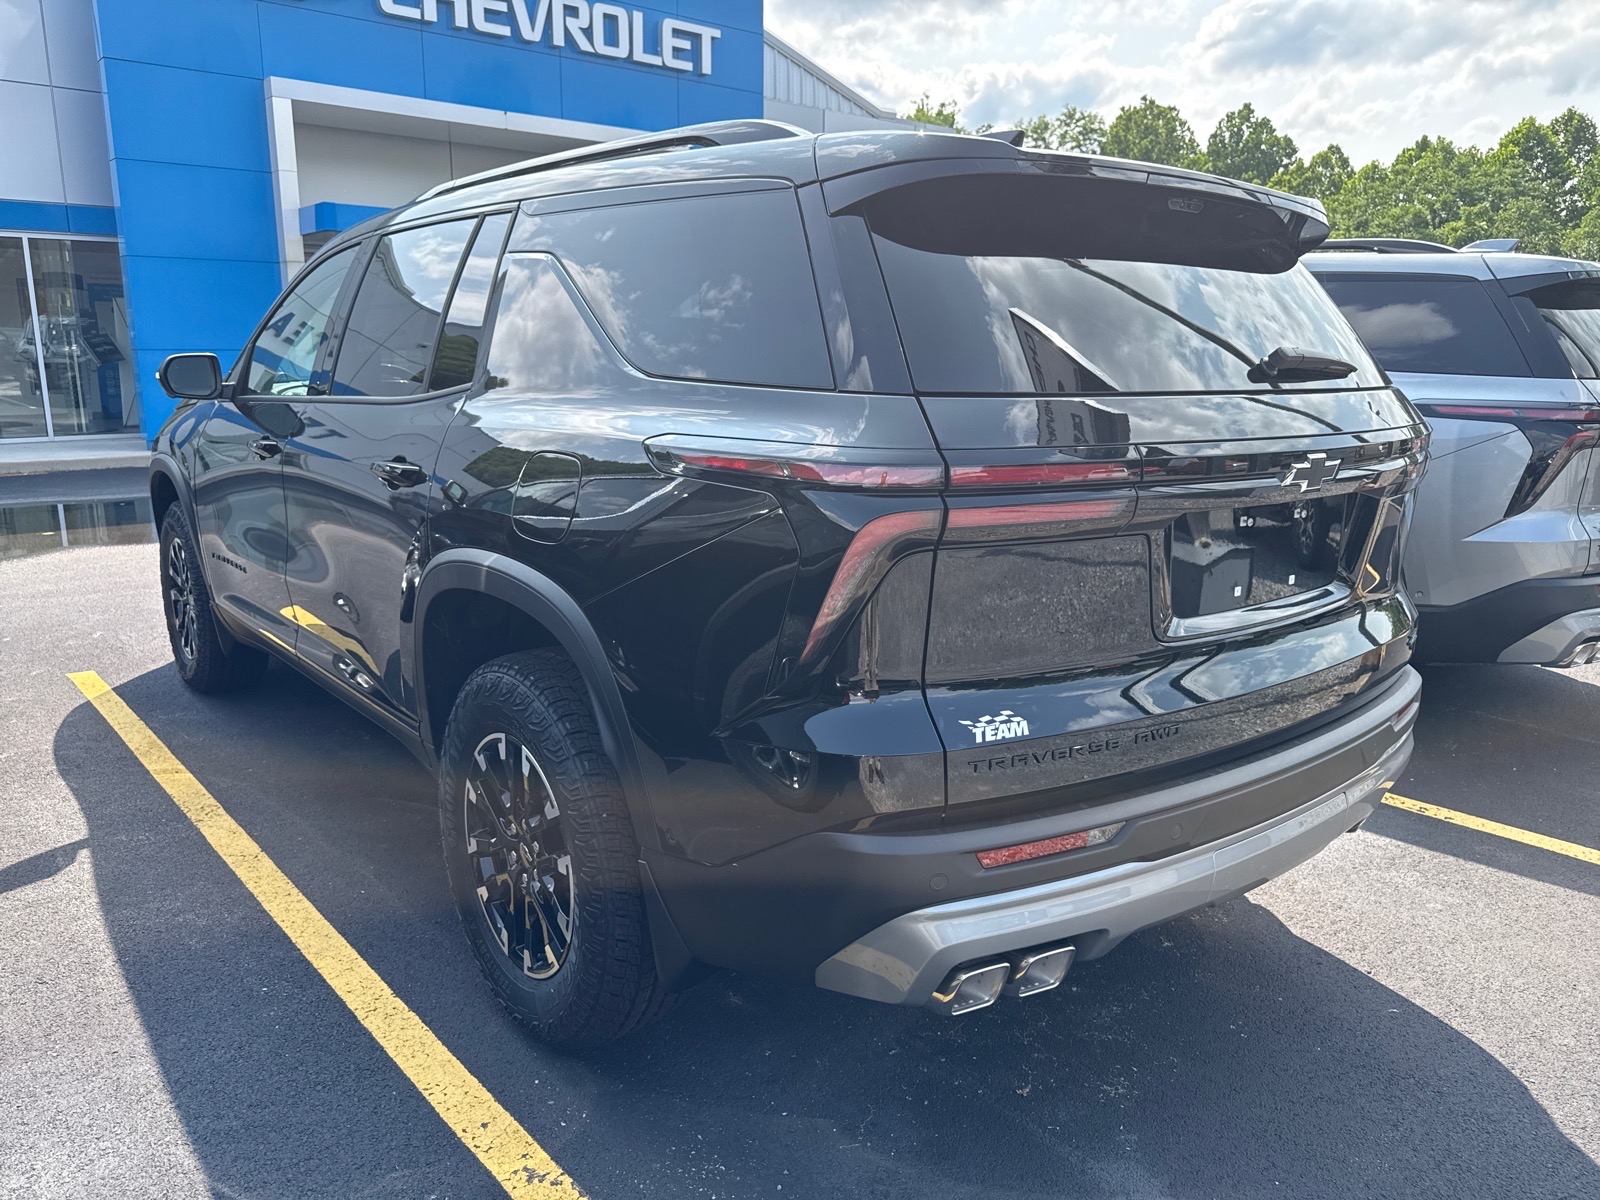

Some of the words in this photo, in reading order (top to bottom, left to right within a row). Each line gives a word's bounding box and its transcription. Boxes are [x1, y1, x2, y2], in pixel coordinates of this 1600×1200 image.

[967, 738, 1121, 774] TRAVERSE
[1134, 723, 1182, 745] AWD
[971, 719, 1030, 744] TEAM
